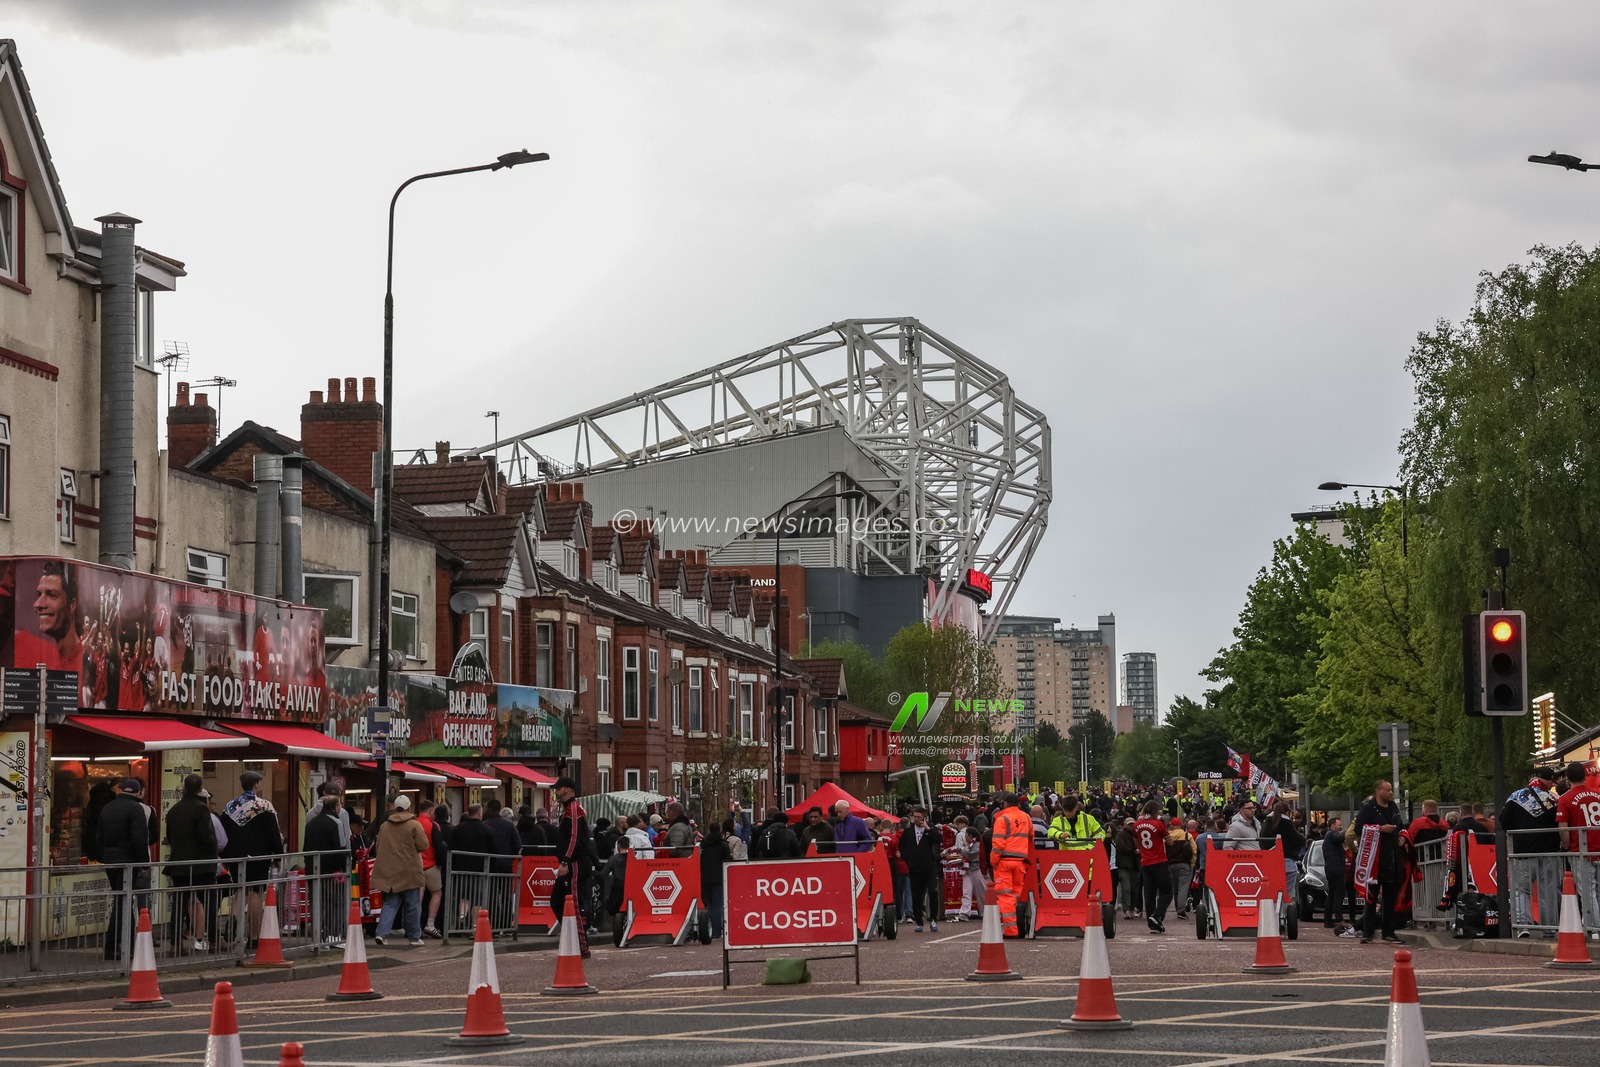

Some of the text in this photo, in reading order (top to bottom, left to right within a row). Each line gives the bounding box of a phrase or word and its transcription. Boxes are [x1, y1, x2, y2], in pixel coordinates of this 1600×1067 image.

[161, 671, 321, 713] FAST FOOD TAKE-AWAY
[448, 690, 467, 714] BAR
[469, 692, 488, 715] AND
[389, 717, 411, 739] CHIPS
[442, 723, 493, 748] OFF-LICENCE
[521, 724, 553, 742] BREAKFAST
[15, 740, 25, 804] FAST FOOD
[1580, 801, 1600, 828] 18
[1140, 830, 1153, 849] 8
[756, 876, 822, 897] ROAD
[743, 908, 838, 930] CLOSED
